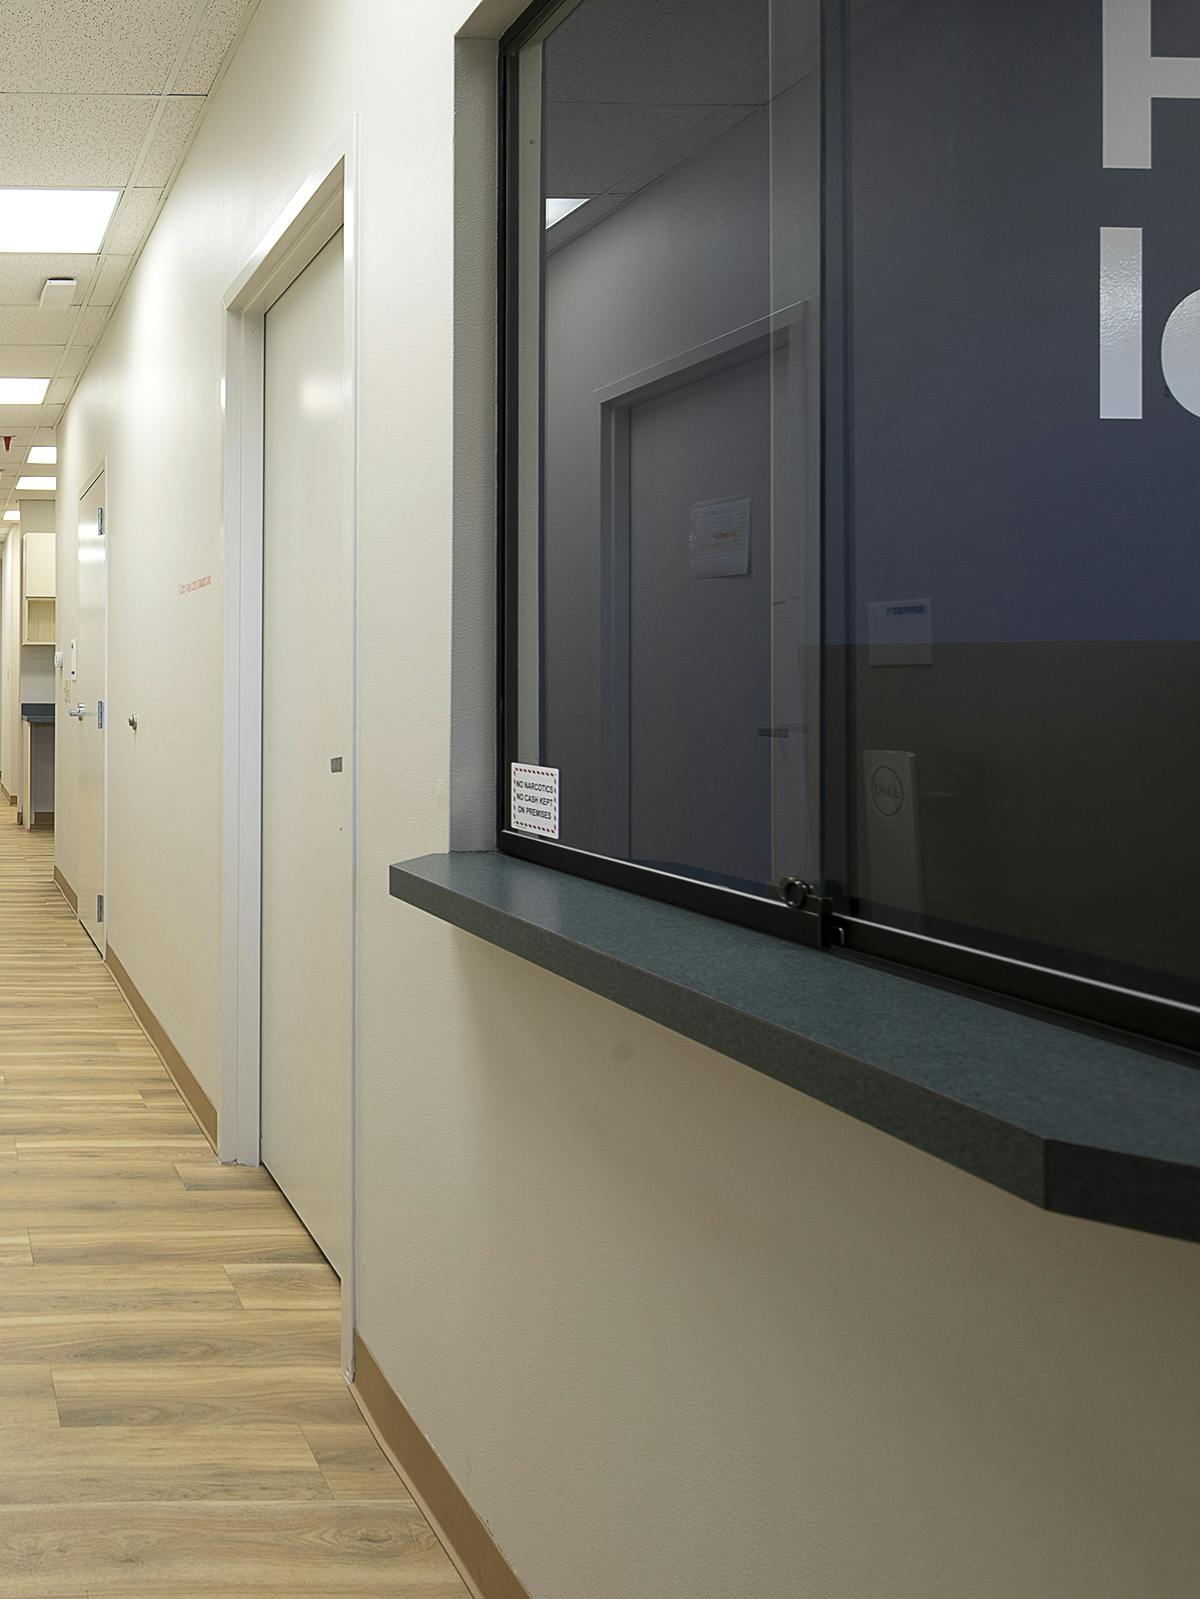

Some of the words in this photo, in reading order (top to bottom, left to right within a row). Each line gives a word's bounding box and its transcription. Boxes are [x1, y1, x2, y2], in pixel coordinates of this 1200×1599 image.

[516, 780, 523, 788] NO
[524, 781, 553, 793] NARCOTICS
[516, 793, 523, 801] NO
[525, 794, 538, 804] CASH
[540, 798, 553, 806] KEPT
[518, 805, 525, 813] ON
[526, 807, 552, 820] PREMISES
